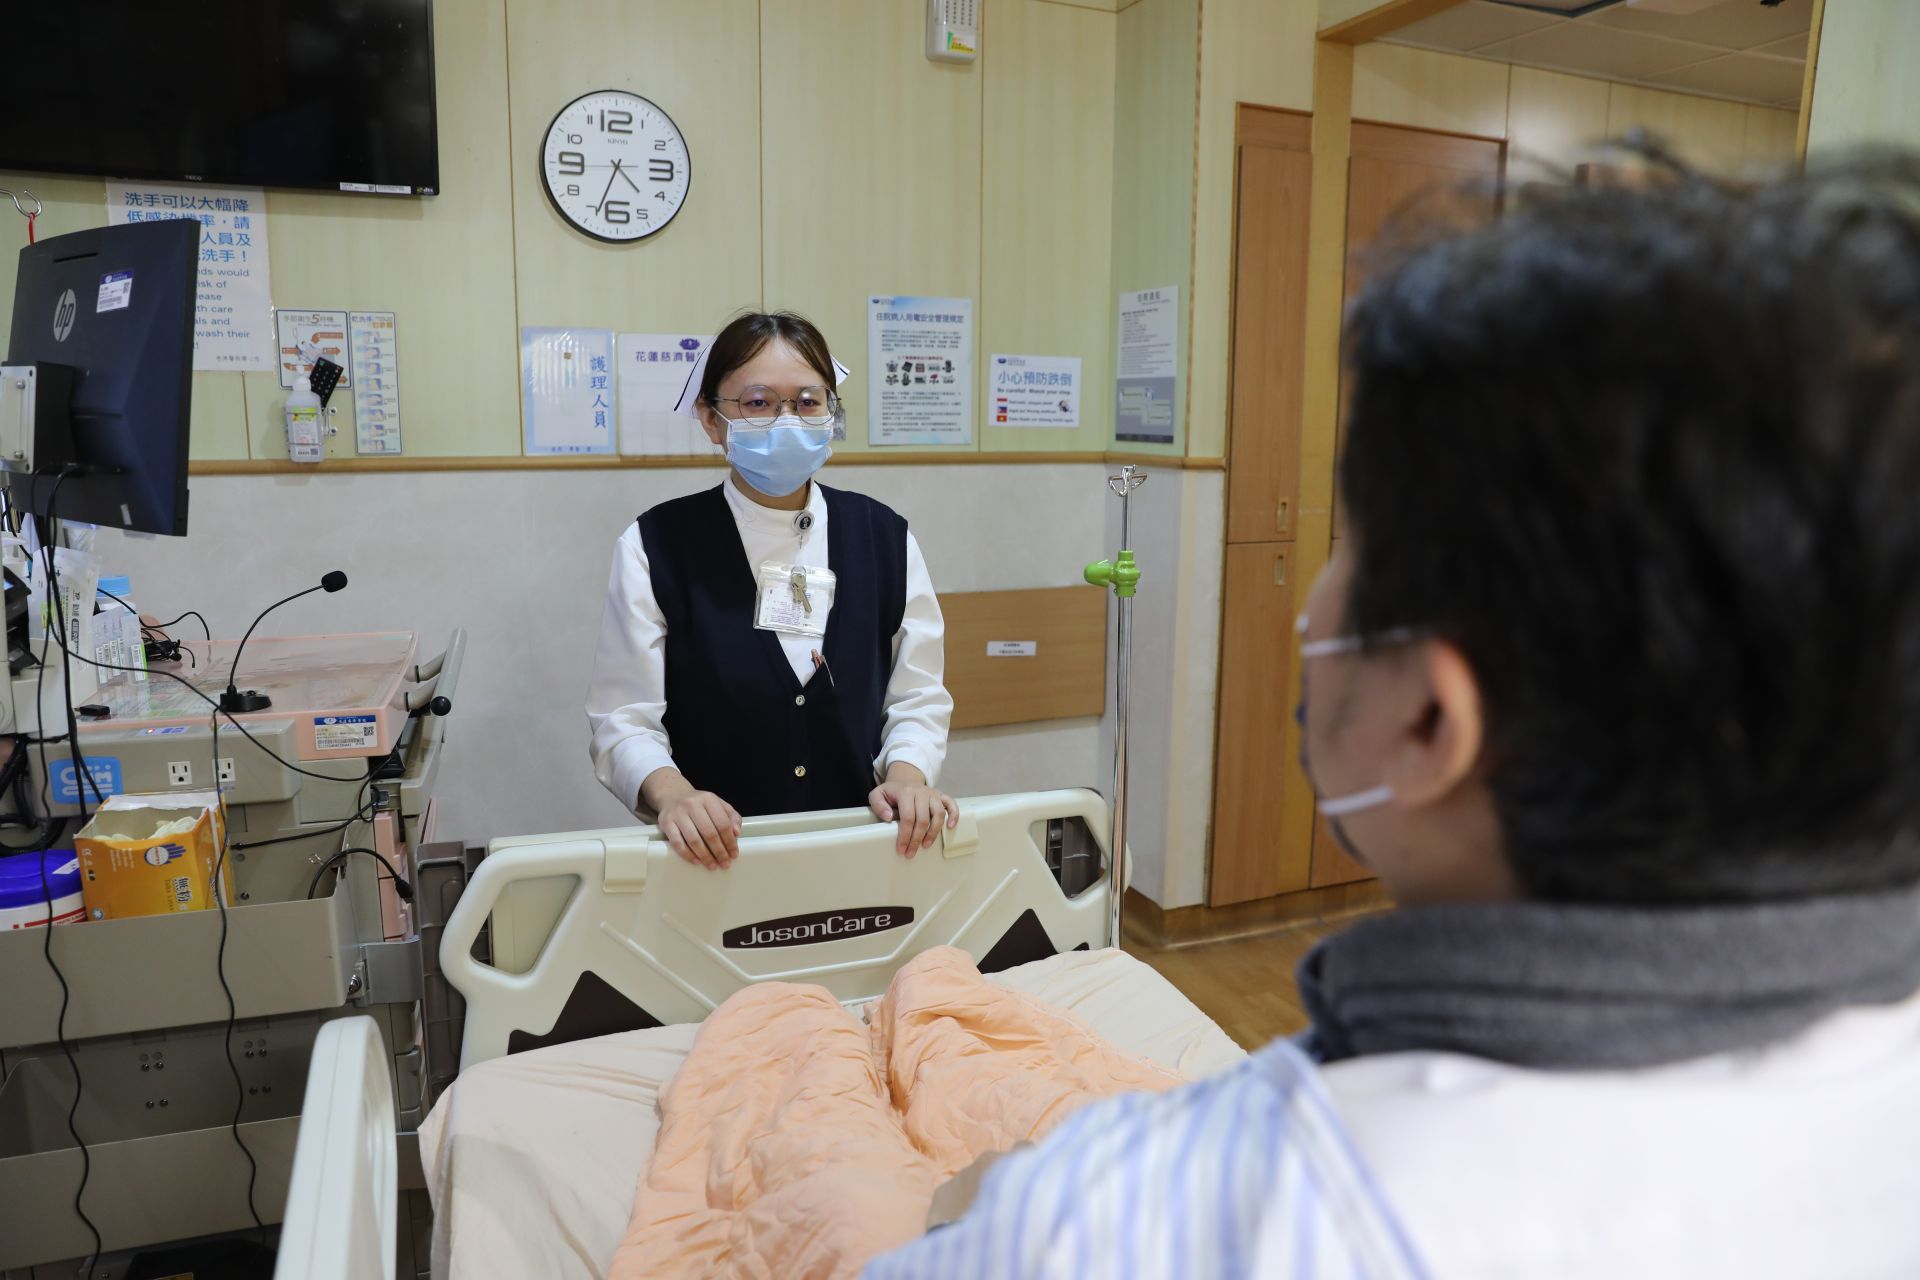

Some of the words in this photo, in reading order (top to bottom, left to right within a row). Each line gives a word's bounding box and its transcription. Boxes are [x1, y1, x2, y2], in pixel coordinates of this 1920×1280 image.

[600, 109, 633, 134] 12
[567, 133, 583, 145] 10
[654, 140, 666, 151] 2
[558, 151, 585, 175] 9
[649, 158, 674, 182] 3
[567, 184, 580, 196] 8
[654, 191, 666, 201] 4
[125, 192, 249, 212] 洗手可以大幅降
[586, 204, 598, 216] 7
[605, 200, 630, 224] 6
[636, 208, 649, 220] 5
[201, 232, 252, 247] 人員及
[200, 248, 247, 263] 洗手！
[198, 267, 214, 276] nds
[217, 268, 250, 277] would
[197, 280, 212, 288] isk
[216, 280, 227, 288] of
[211, 317, 231, 325] and
[195, 329, 223, 337] wash
[227, 330, 251, 338] their
[635, 351, 701, 363] 花蓮慈濟醫
[998, 370, 1073, 387] 小心預防跌倒
[589, 355, 609, 430] 護理人員
[740, 913, 892, 946] JosonCare
